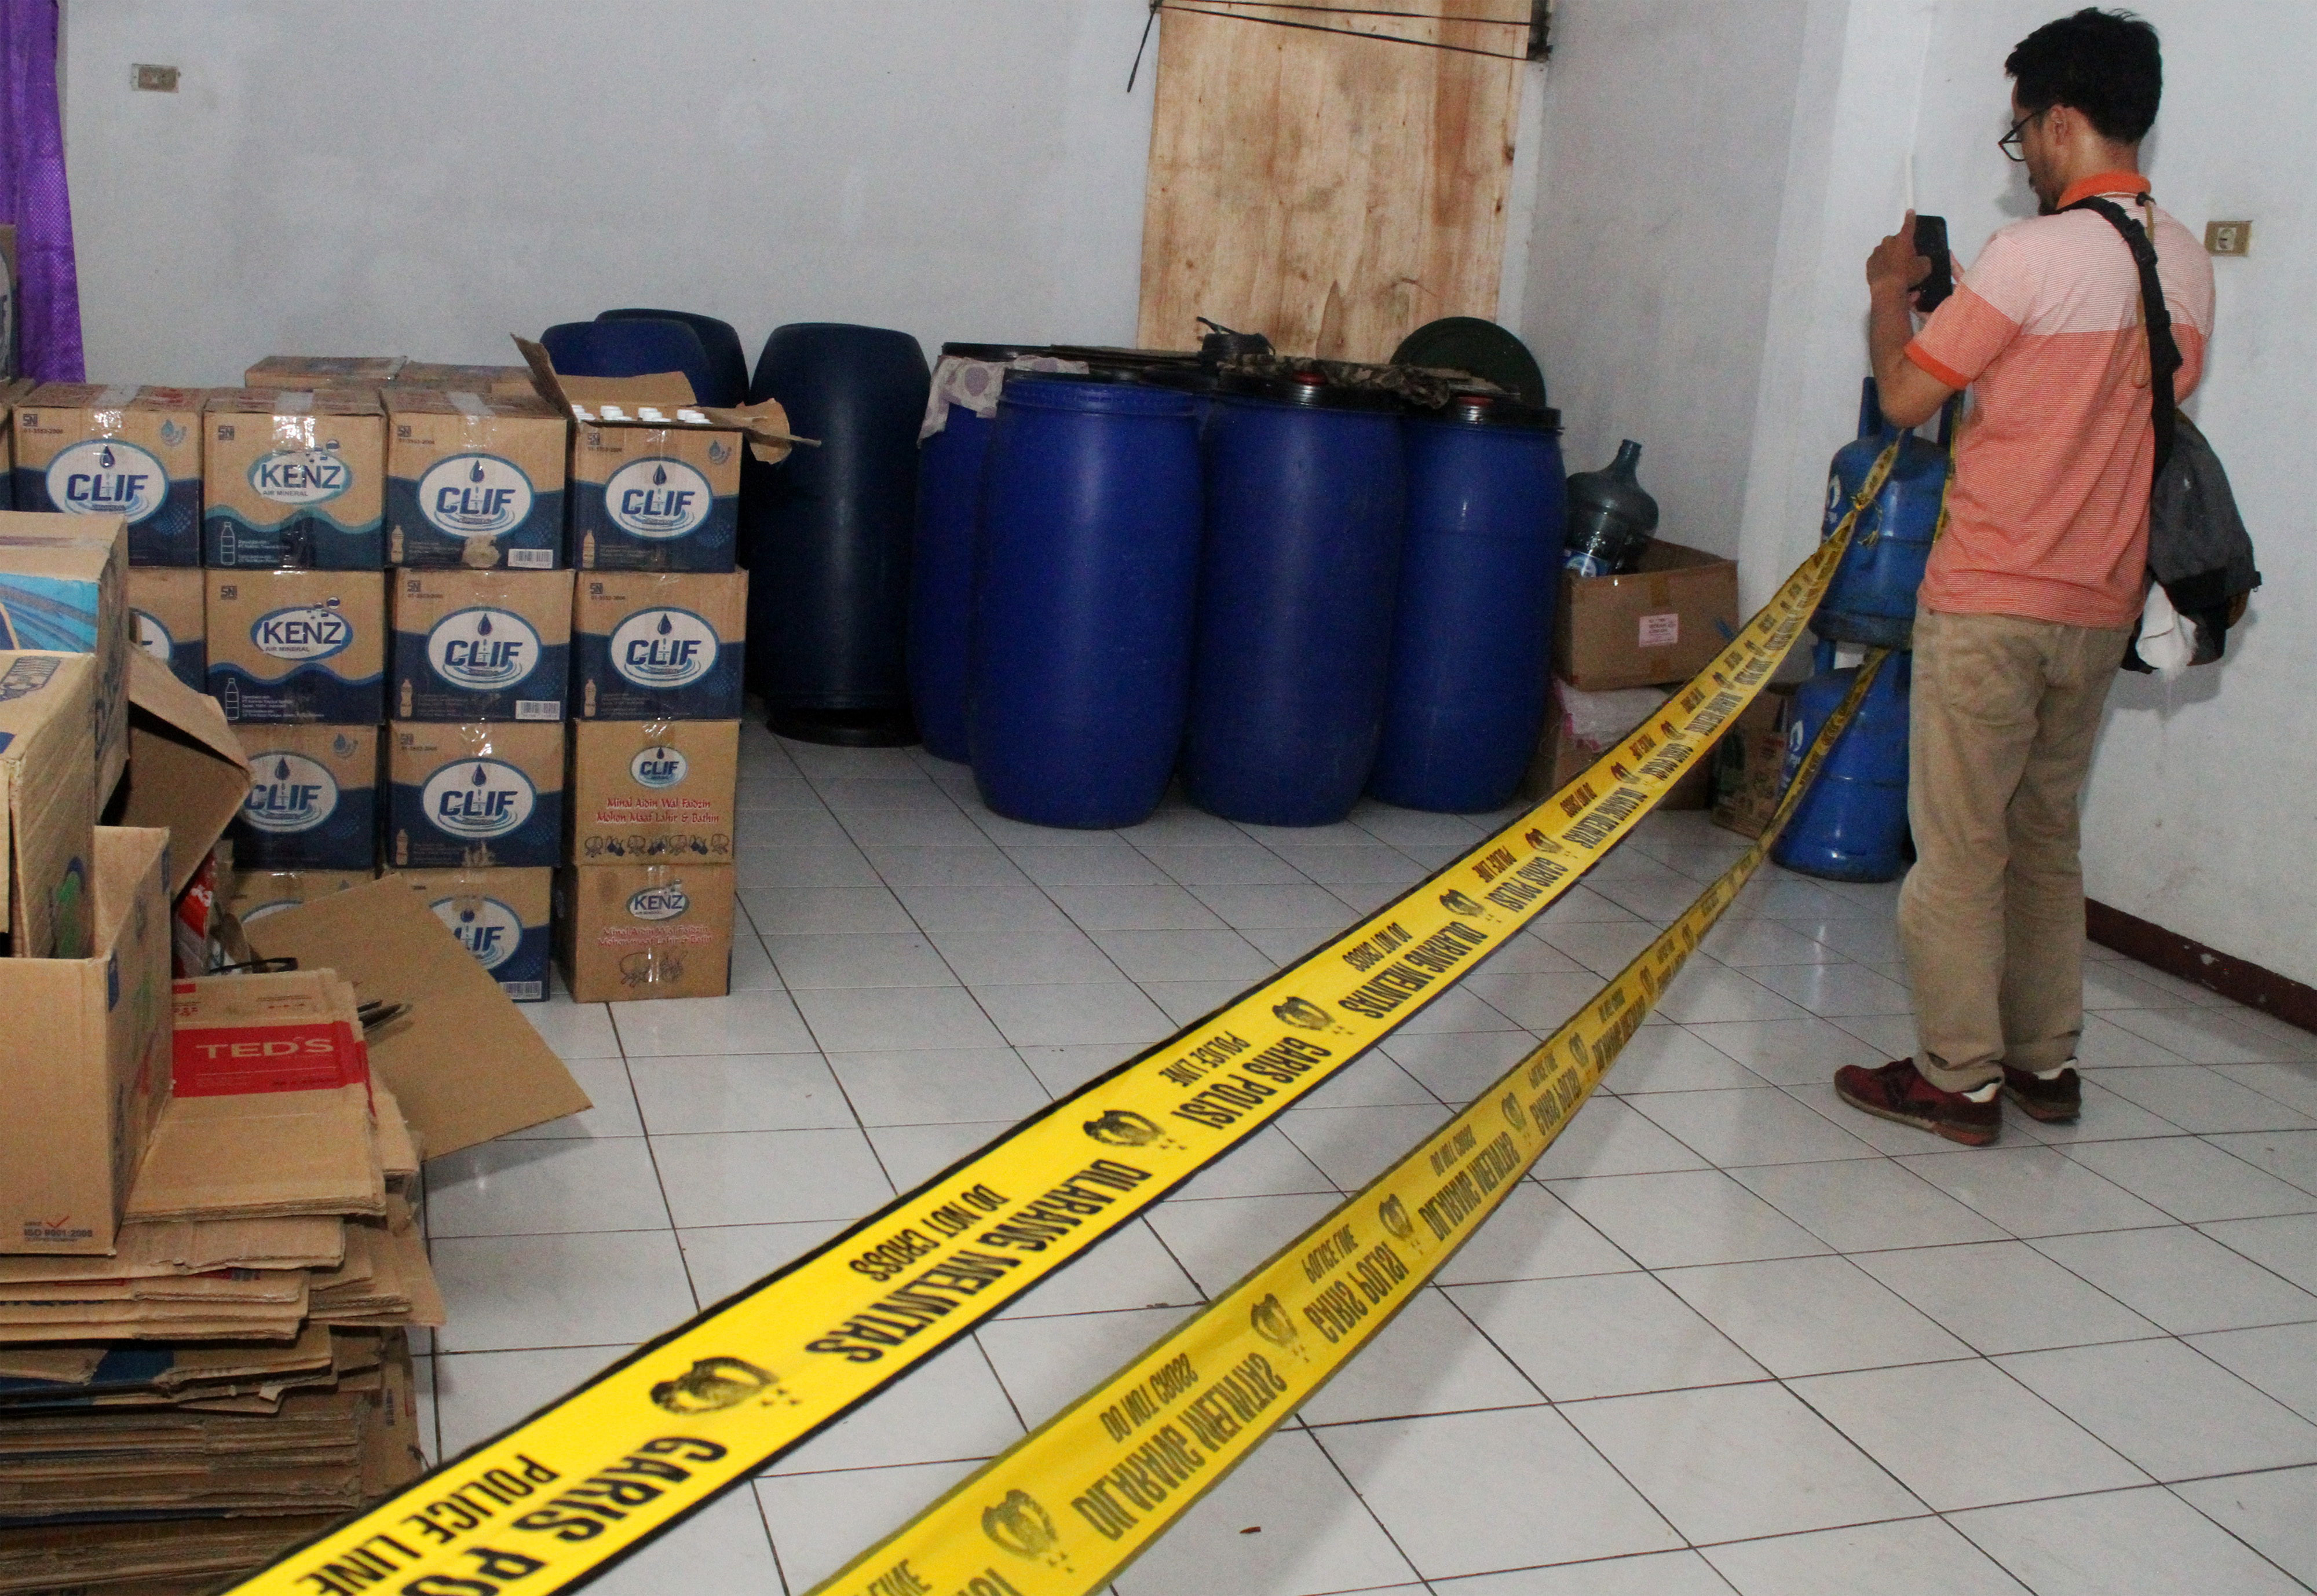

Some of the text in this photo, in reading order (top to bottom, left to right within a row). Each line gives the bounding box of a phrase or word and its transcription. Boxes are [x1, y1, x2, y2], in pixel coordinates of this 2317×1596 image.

[67, 474, 149, 502] CLIF
[261, 464, 341, 489] KENZ
[436, 486, 516, 515] CLIF
[621, 489, 695, 517] CLIF
[264, 621, 342, 644] KENZ
[445, 640, 523, 667] CLIF
[626, 639, 702, 665] CLIF
[639, 761, 679, 775] CLIF
[243, 784, 322, 810] CLIF
[440, 790, 518, 816] CLIF
[662, 797, 678, 808] Wal
[634, 895, 684, 910] KENZ
[1484, 877, 1544, 913] POLISI
[1338, 921, 1489, 1019] DILARANG MELINTAS
[1158, 1031, 1251, 1088] POLICE LINE
[1170, 1037, 1332, 1130] GARIS POLISI
[849, 1183, 1011, 1282] DO NOT CROSS
[805, 1158, 1153, 1363] DILARANG MELINTAS
[400, 1454, 560, 1544] POLICE
[511, 1436, 728, 1542] GARIS
